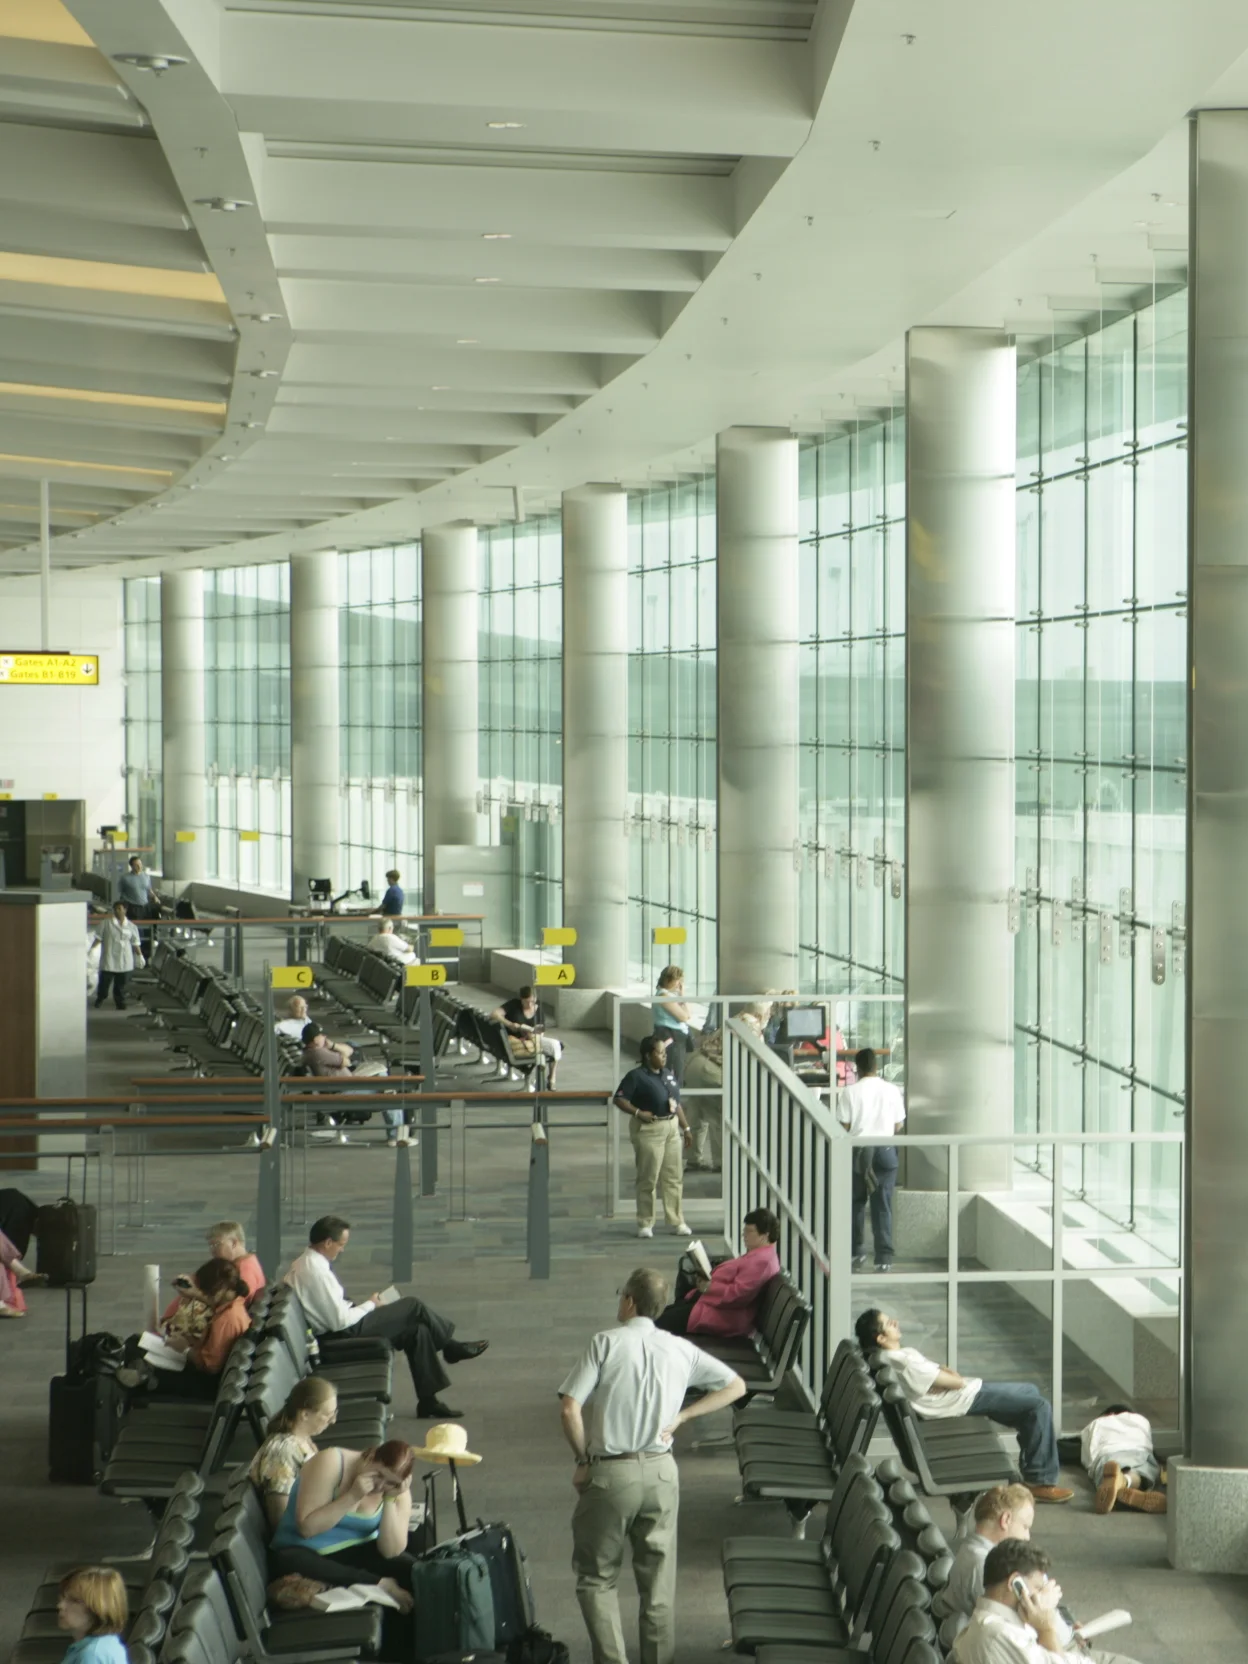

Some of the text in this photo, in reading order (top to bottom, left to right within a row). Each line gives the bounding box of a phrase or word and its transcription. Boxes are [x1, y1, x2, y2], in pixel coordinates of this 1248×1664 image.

[15, 658, 43, 666] Gates
[10, 670, 39, 678] Gates
[296, 971, 306, 983] C
[431, 969, 440, 981] B
[557, 969, 568, 980] A
